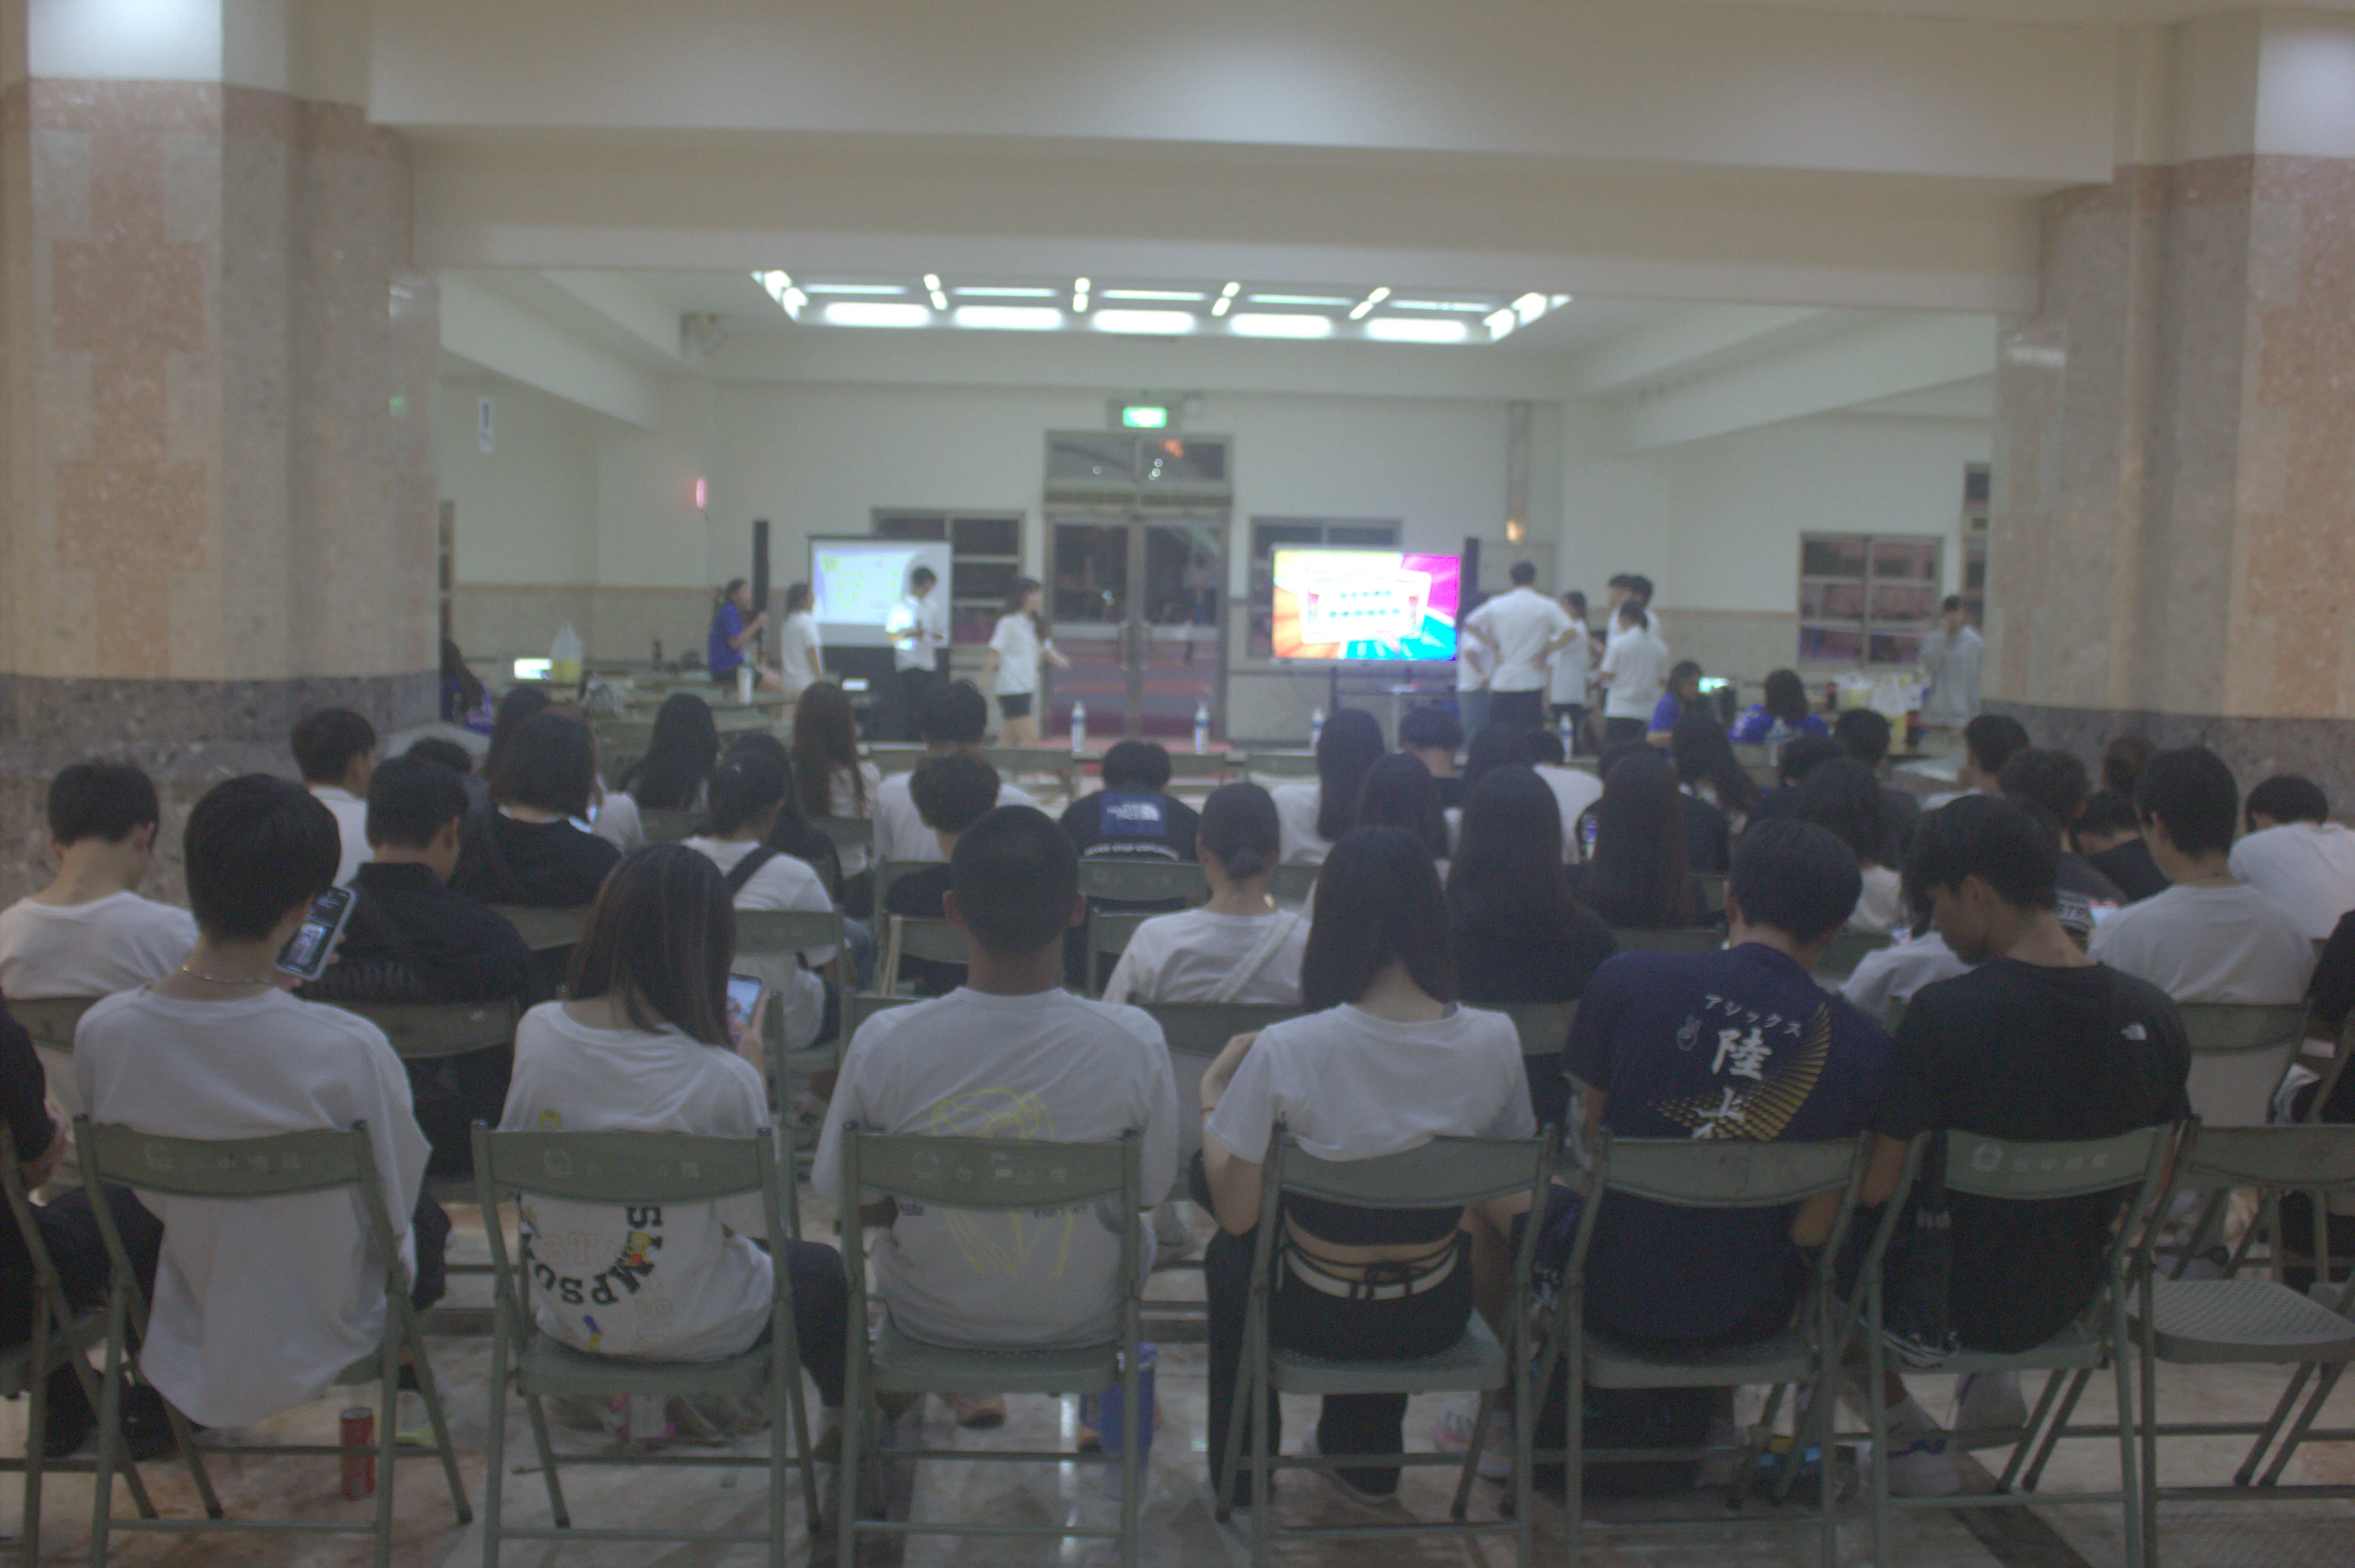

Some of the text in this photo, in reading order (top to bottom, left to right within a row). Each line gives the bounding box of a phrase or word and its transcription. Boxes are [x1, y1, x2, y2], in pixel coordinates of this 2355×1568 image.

[1704, 994, 1802, 1038] アシックス
[1692, 1027, 1773, 1139] 陸上
